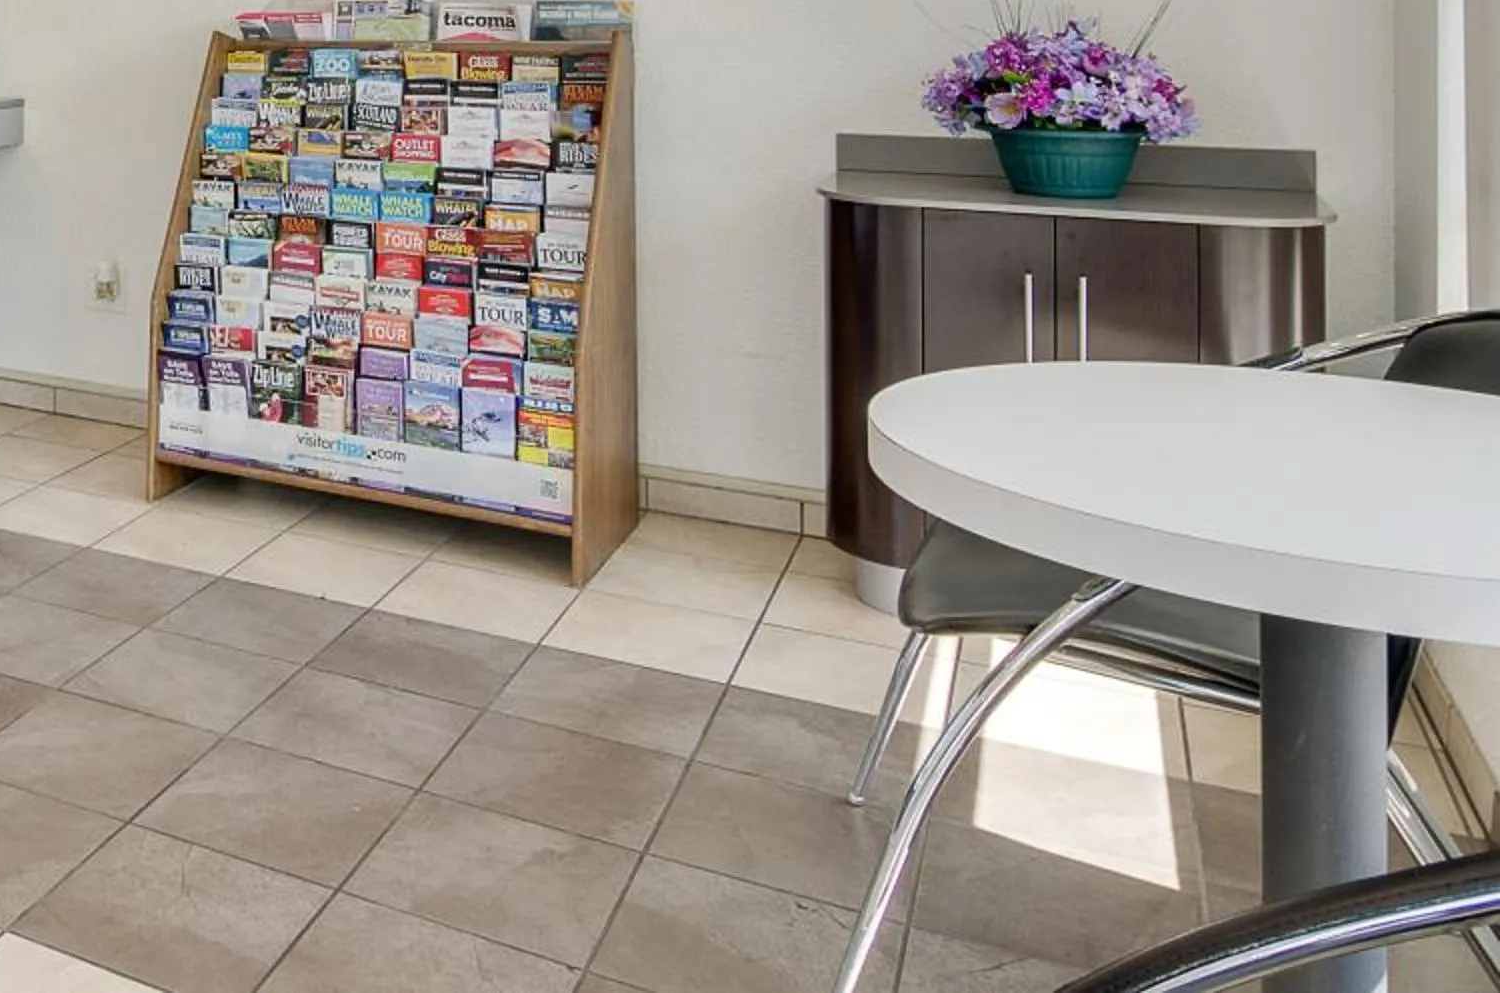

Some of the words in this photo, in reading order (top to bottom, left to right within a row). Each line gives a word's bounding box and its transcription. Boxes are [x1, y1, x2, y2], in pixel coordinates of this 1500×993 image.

[443, 10, 516, 29] tacoma
[394, 138, 436, 151] OUTLET
[381, 195, 422, 207] WHALE
[383, 206, 423, 218] WATCH
[384, 233, 423, 249] TOUR
[540, 247, 587, 264] TOUR
[479, 306, 525, 325] TOUR
[366, 325, 407, 342] TOUR
[296, 431, 408, 463] visitortips.com
